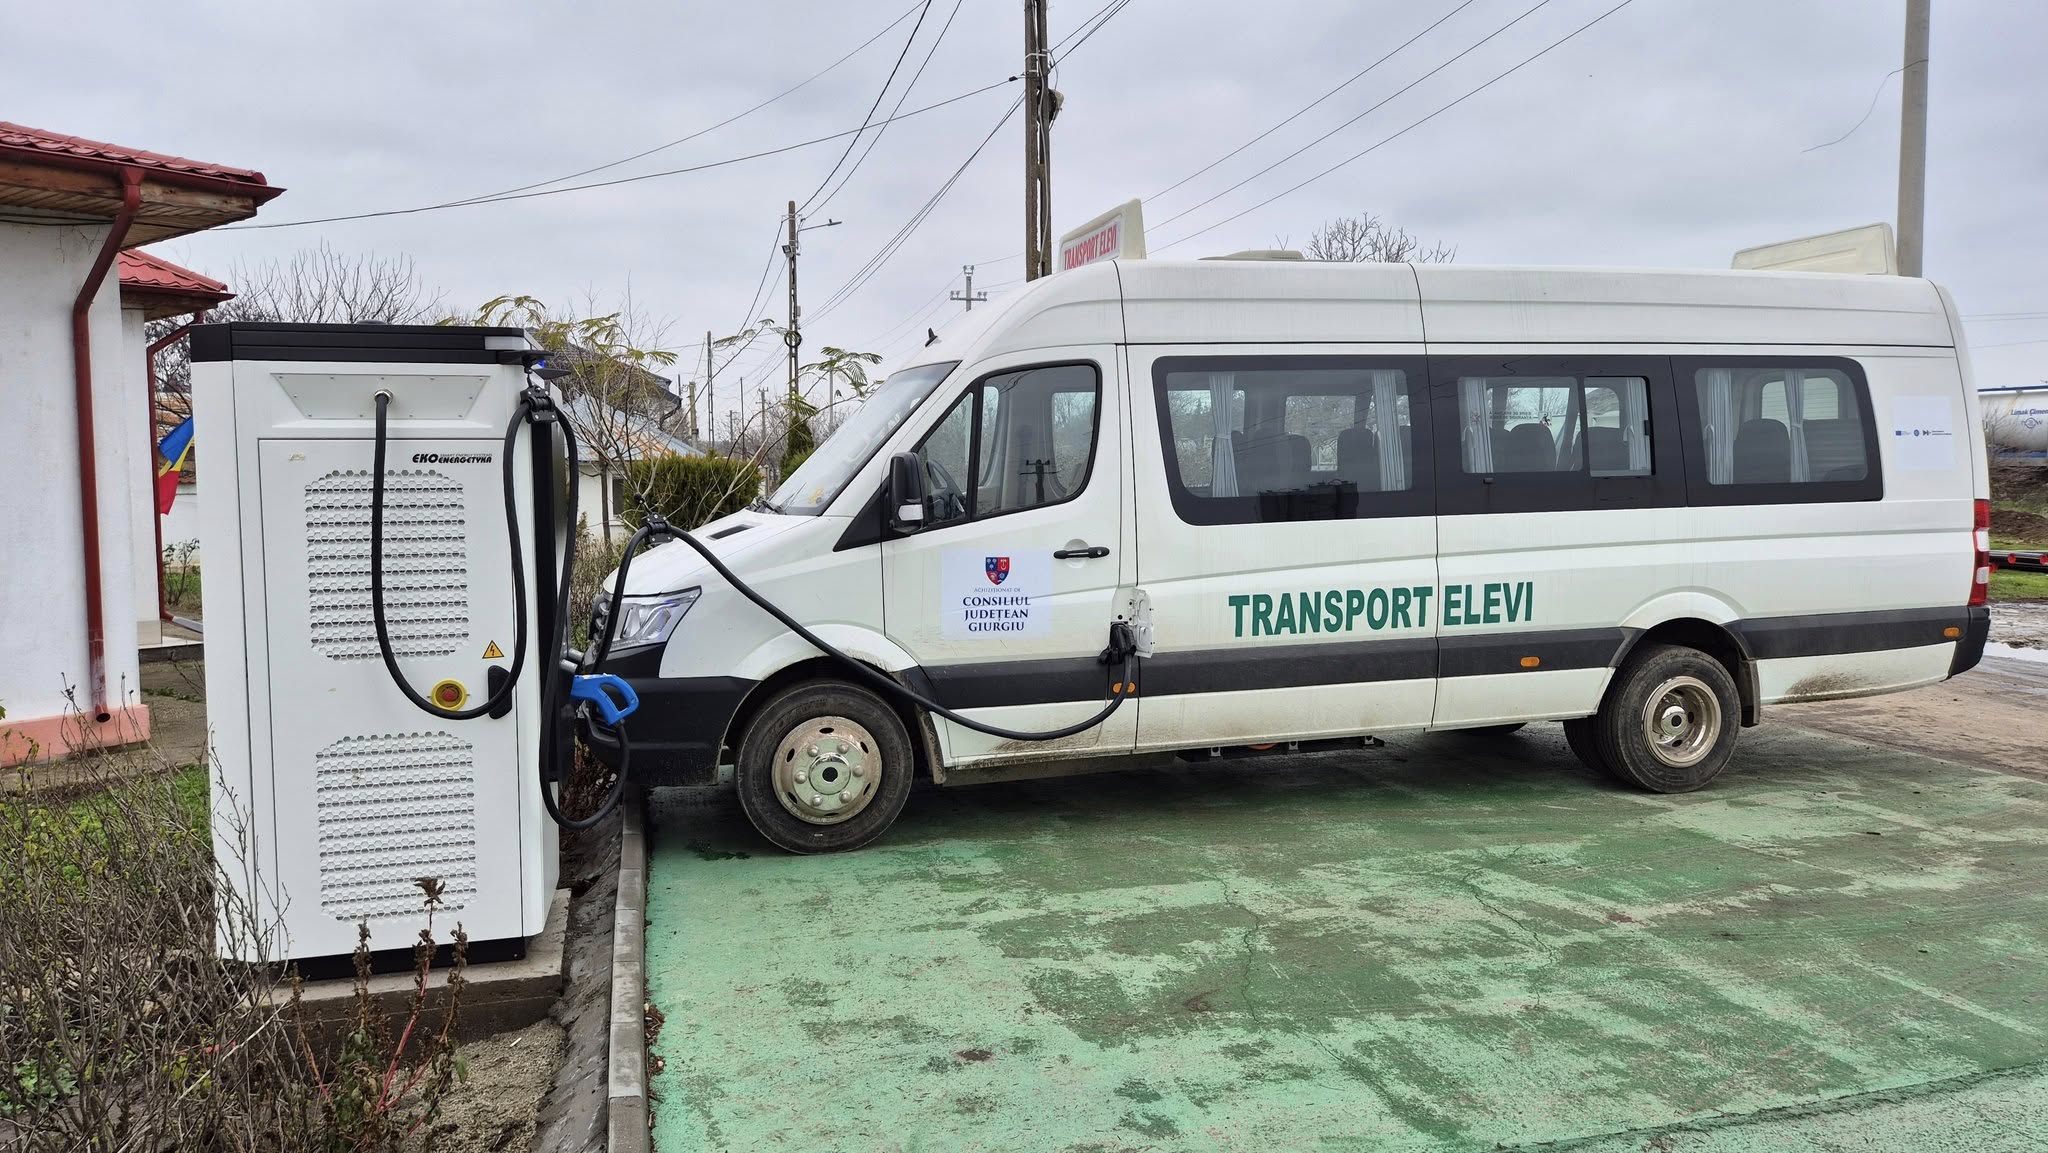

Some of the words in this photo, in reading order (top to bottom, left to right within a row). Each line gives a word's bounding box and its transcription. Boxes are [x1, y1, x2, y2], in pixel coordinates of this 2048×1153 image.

[1063, 234, 1099, 271] TRANSPORT
[1099, 223, 1118, 257] ELEVI
[962, 596, 1031, 606] CONSILIUL
[964, 609, 1029, 621] JUDEȚEAN
[1228, 586, 1433, 638] TRANSPORT
[1443, 581, 1534, 626] ELEVI
[968, 621, 1025, 632] GIURGIU
